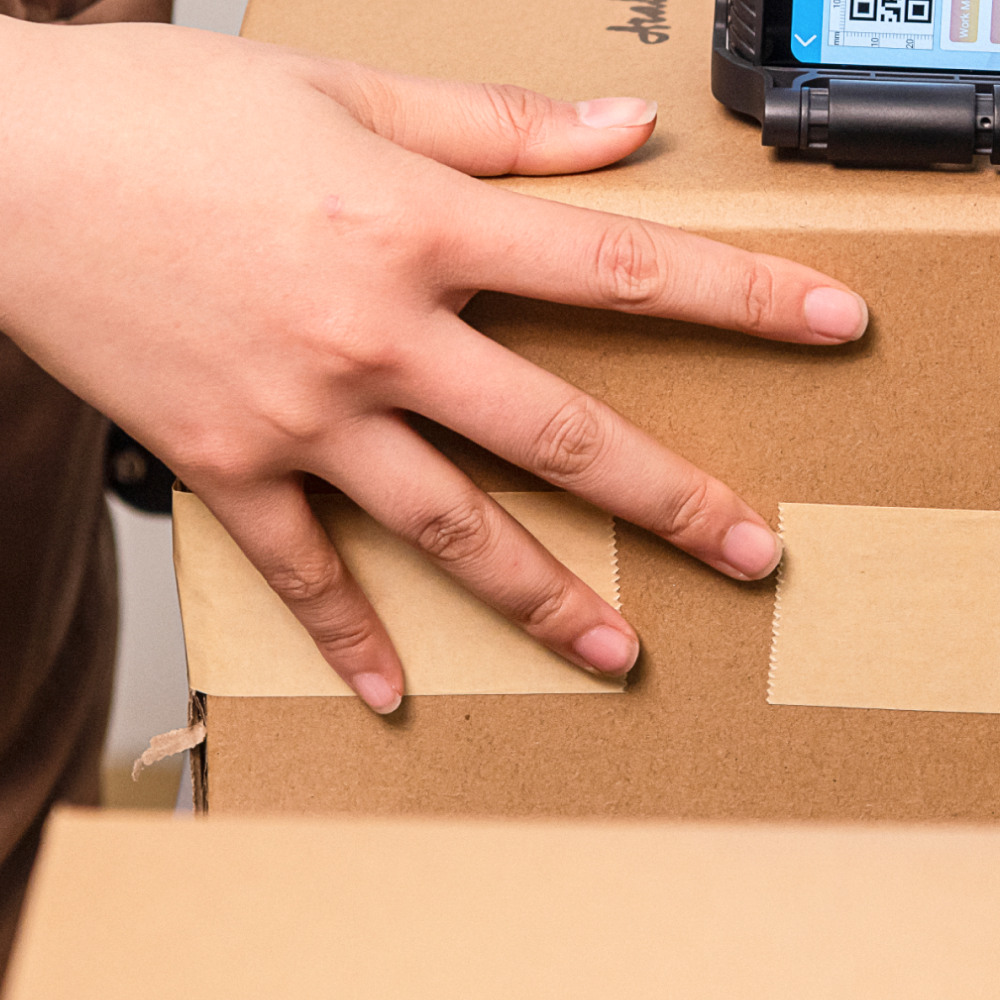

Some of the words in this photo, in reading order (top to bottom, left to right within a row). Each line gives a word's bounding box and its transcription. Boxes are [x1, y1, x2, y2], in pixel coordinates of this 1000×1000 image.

[959, 10, 970, 39] Work
[834, 31, 840, 46] mm
[871, 37, 878, 47] 10
[906, 38, 914, 49] 20
